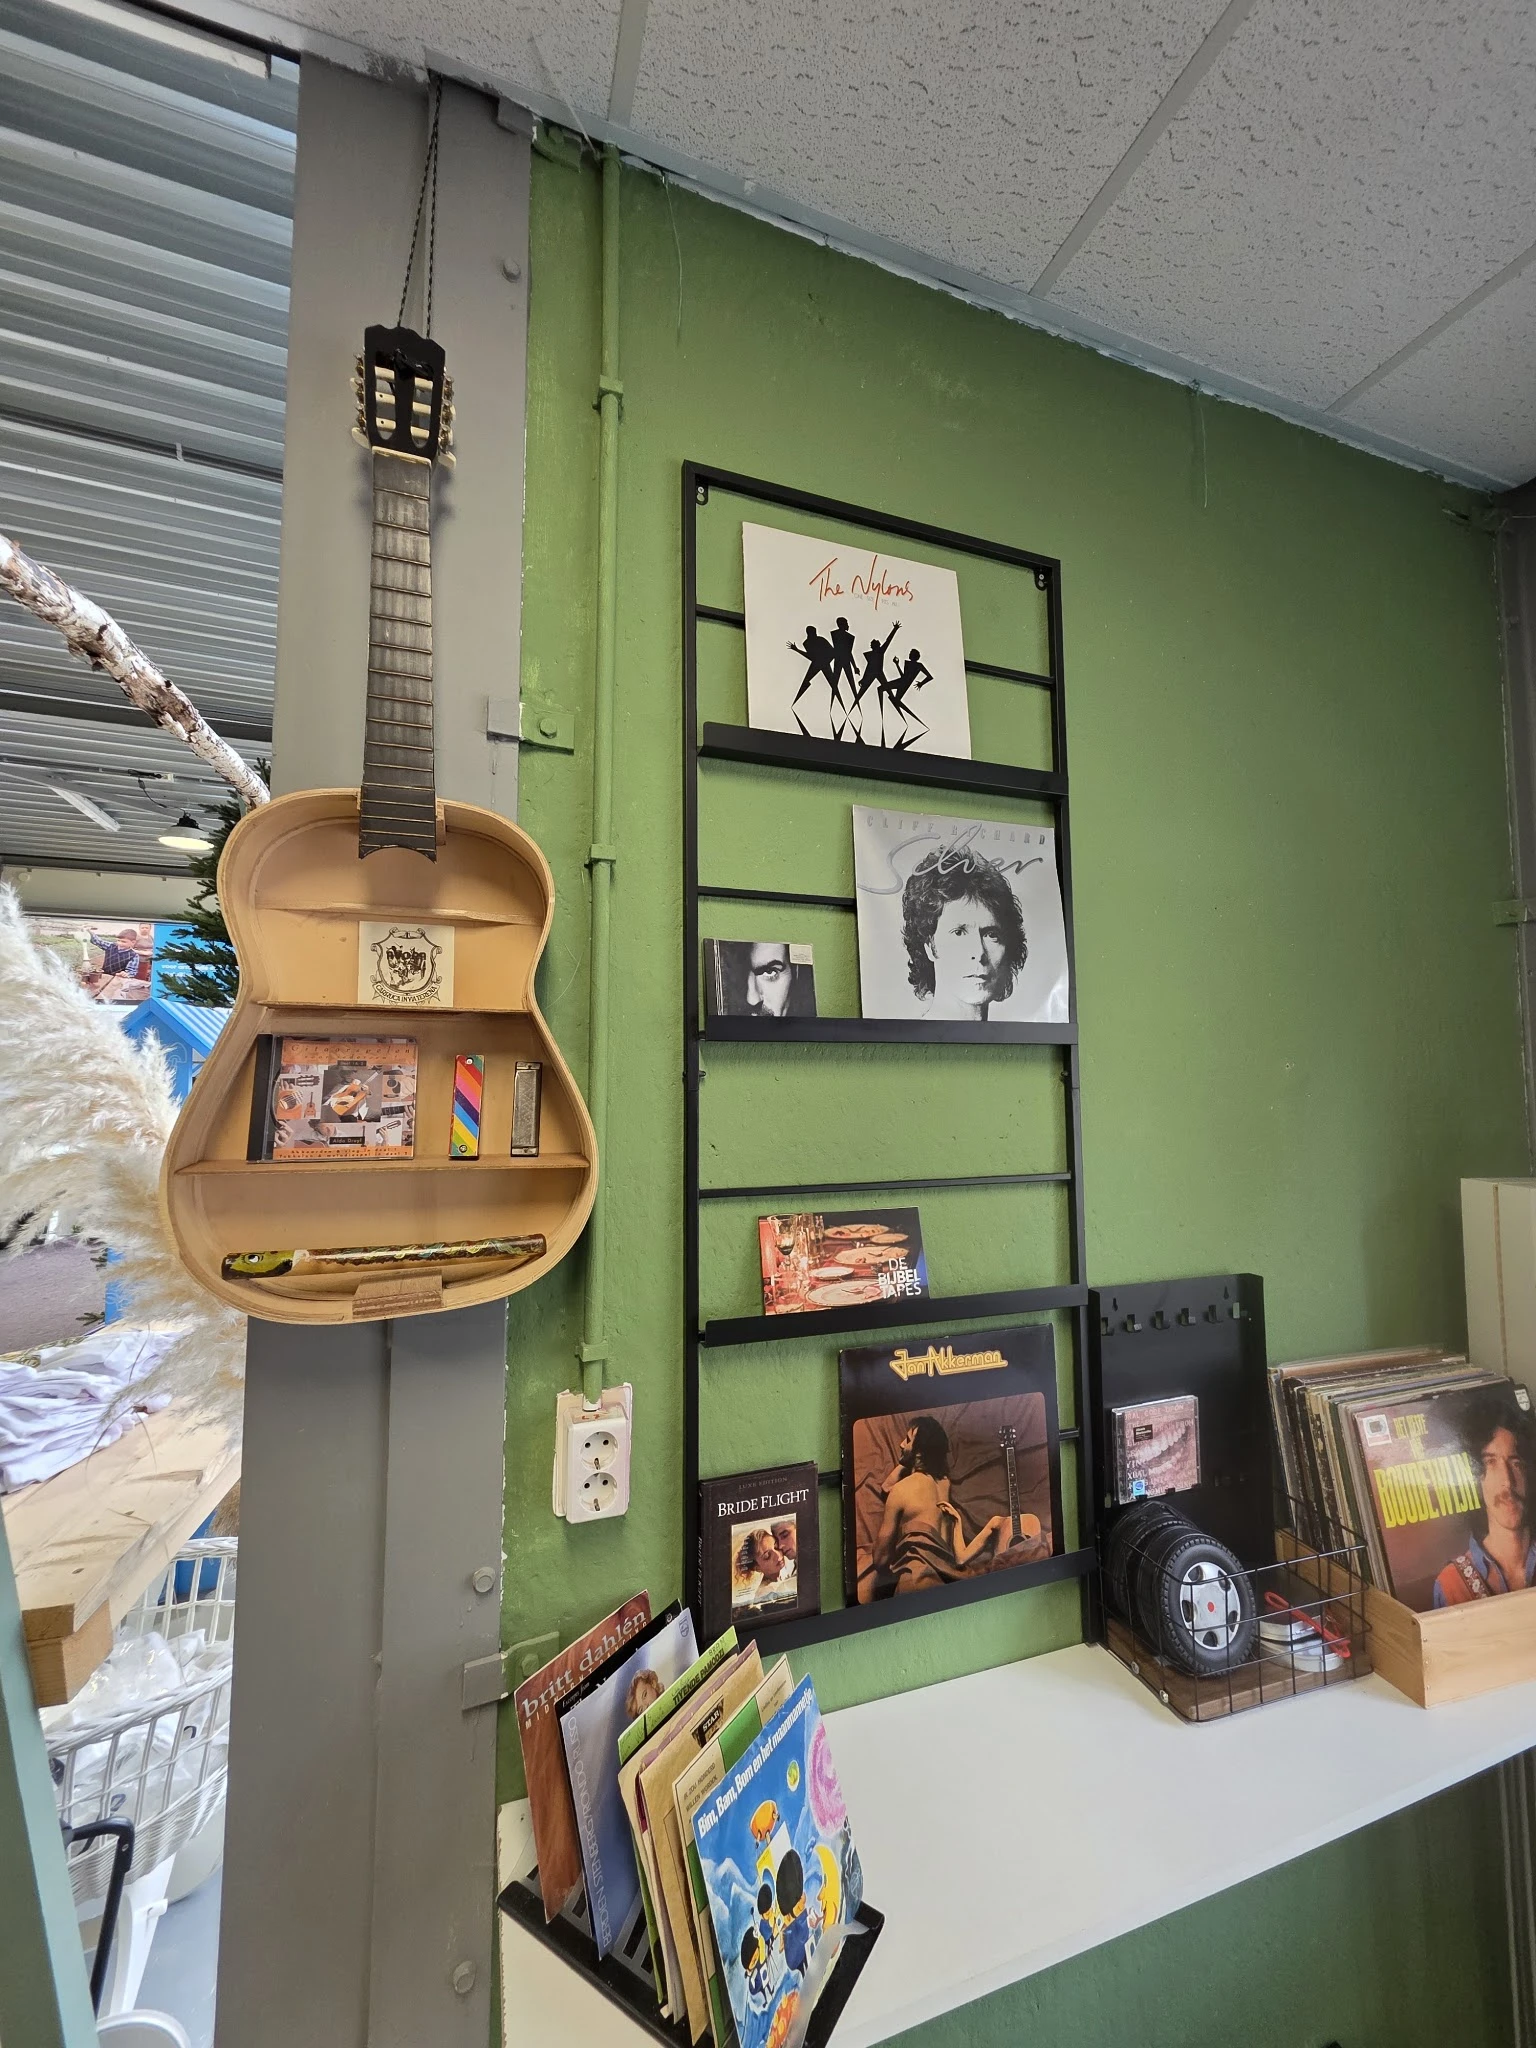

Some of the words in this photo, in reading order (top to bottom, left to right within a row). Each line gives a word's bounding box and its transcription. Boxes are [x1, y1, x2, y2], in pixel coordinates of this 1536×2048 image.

[809, 557, 844, 602] The
[851, 555, 914, 610] Nylons
[866, 815, 934, 833] CLIFF
[950, 823, 1046, 846] RICHARD
[857, 823, 1044, 895] Silver
[877, 1268, 922, 1286] BIJBEL
[888, 1256, 908, 1272] DE
[880, 1282, 922, 1300] TAPES
[889, 1348, 926, 1382] Jan
[926, 1345, 1009, 1378] Akkerman
[717, 1498, 759, 1518] BRIDE
[761, 1488, 810, 1510] FLIGHT
[1373, 1452, 1481, 1528] BOUDEWIJN
[522, 1668, 574, 1718] britt
[579, 1610, 647, 1672] dahlén
[697, 1808, 719, 1840] Bim,
[715, 1785, 738, 1818] Bam,
[734, 1764, 754, 1794] Bom
[752, 1752, 763, 1774] en
[760, 1734, 775, 1764] het
[771, 1687, 813, 1750] maanmannetje
